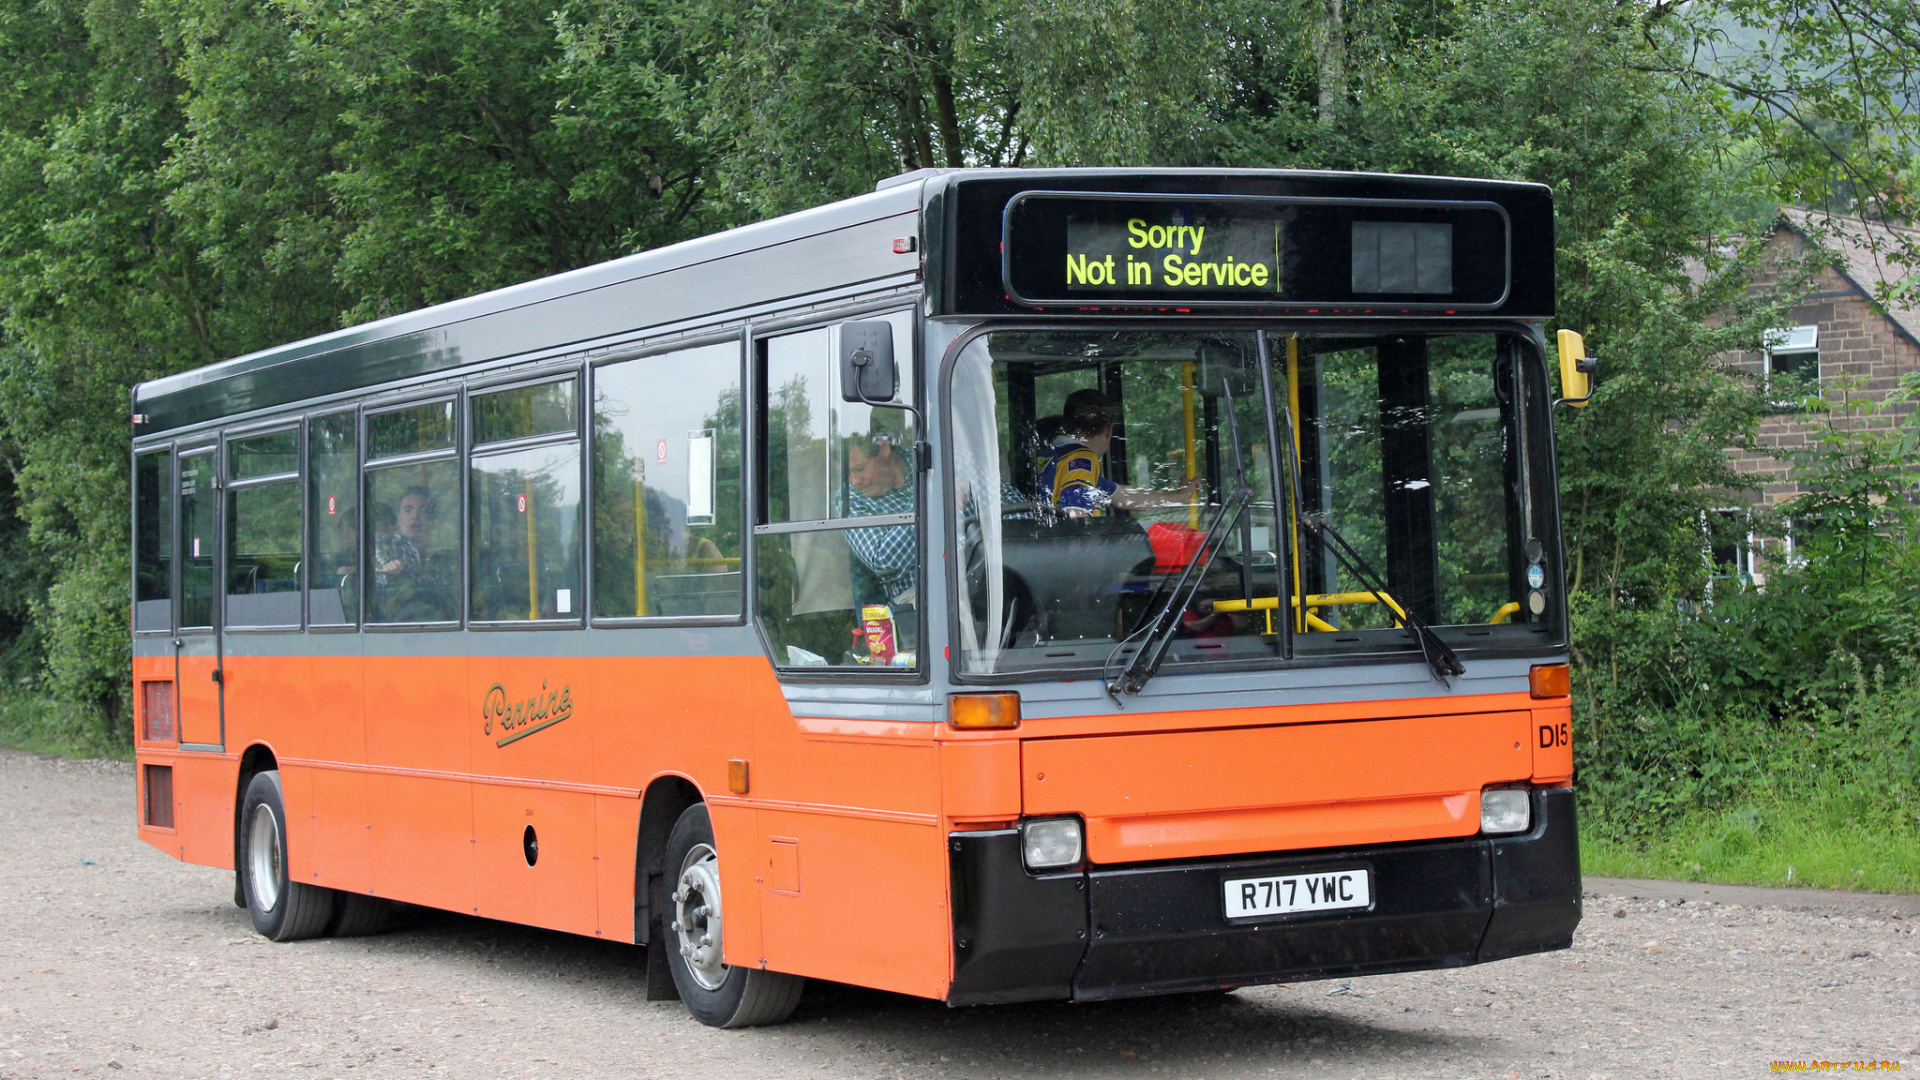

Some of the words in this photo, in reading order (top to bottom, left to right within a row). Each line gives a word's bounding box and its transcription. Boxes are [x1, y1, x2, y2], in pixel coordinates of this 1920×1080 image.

[1127, 219, 1205, 255] Sorry
[1066, 253, 1117, 286] Not
[1126, 254, 1152, 286] in
[1163, 253, 1269, 287] Service
[483, 678, 573, 738] Pennine
[1539, 722, 1568, 749] D15
[1241, 879, 1297, 910] R717
[1305, 875, 1354, 905] YWC
